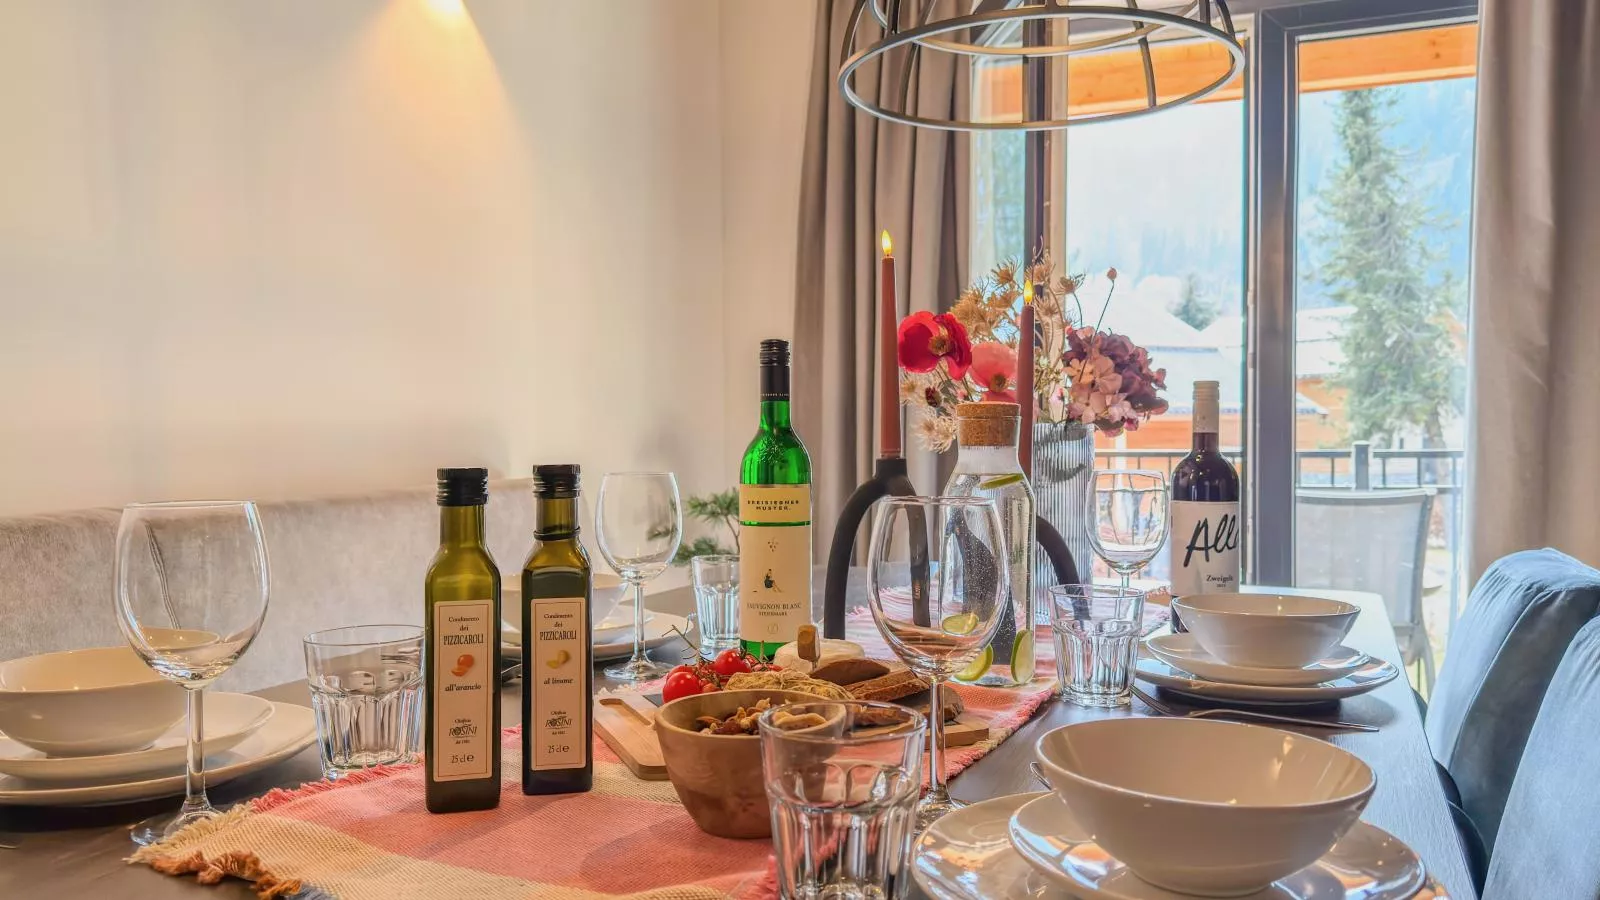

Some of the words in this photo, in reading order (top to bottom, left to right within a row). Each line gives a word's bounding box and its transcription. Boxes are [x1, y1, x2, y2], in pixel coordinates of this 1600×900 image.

[443, 633, 484, 646] PIZZICAROLI
[539, 630, 577, 641] PIZZICAROLI
[545, 718, 573, 728] ROSINI
[448, 725, 478, 737] ROSINI
